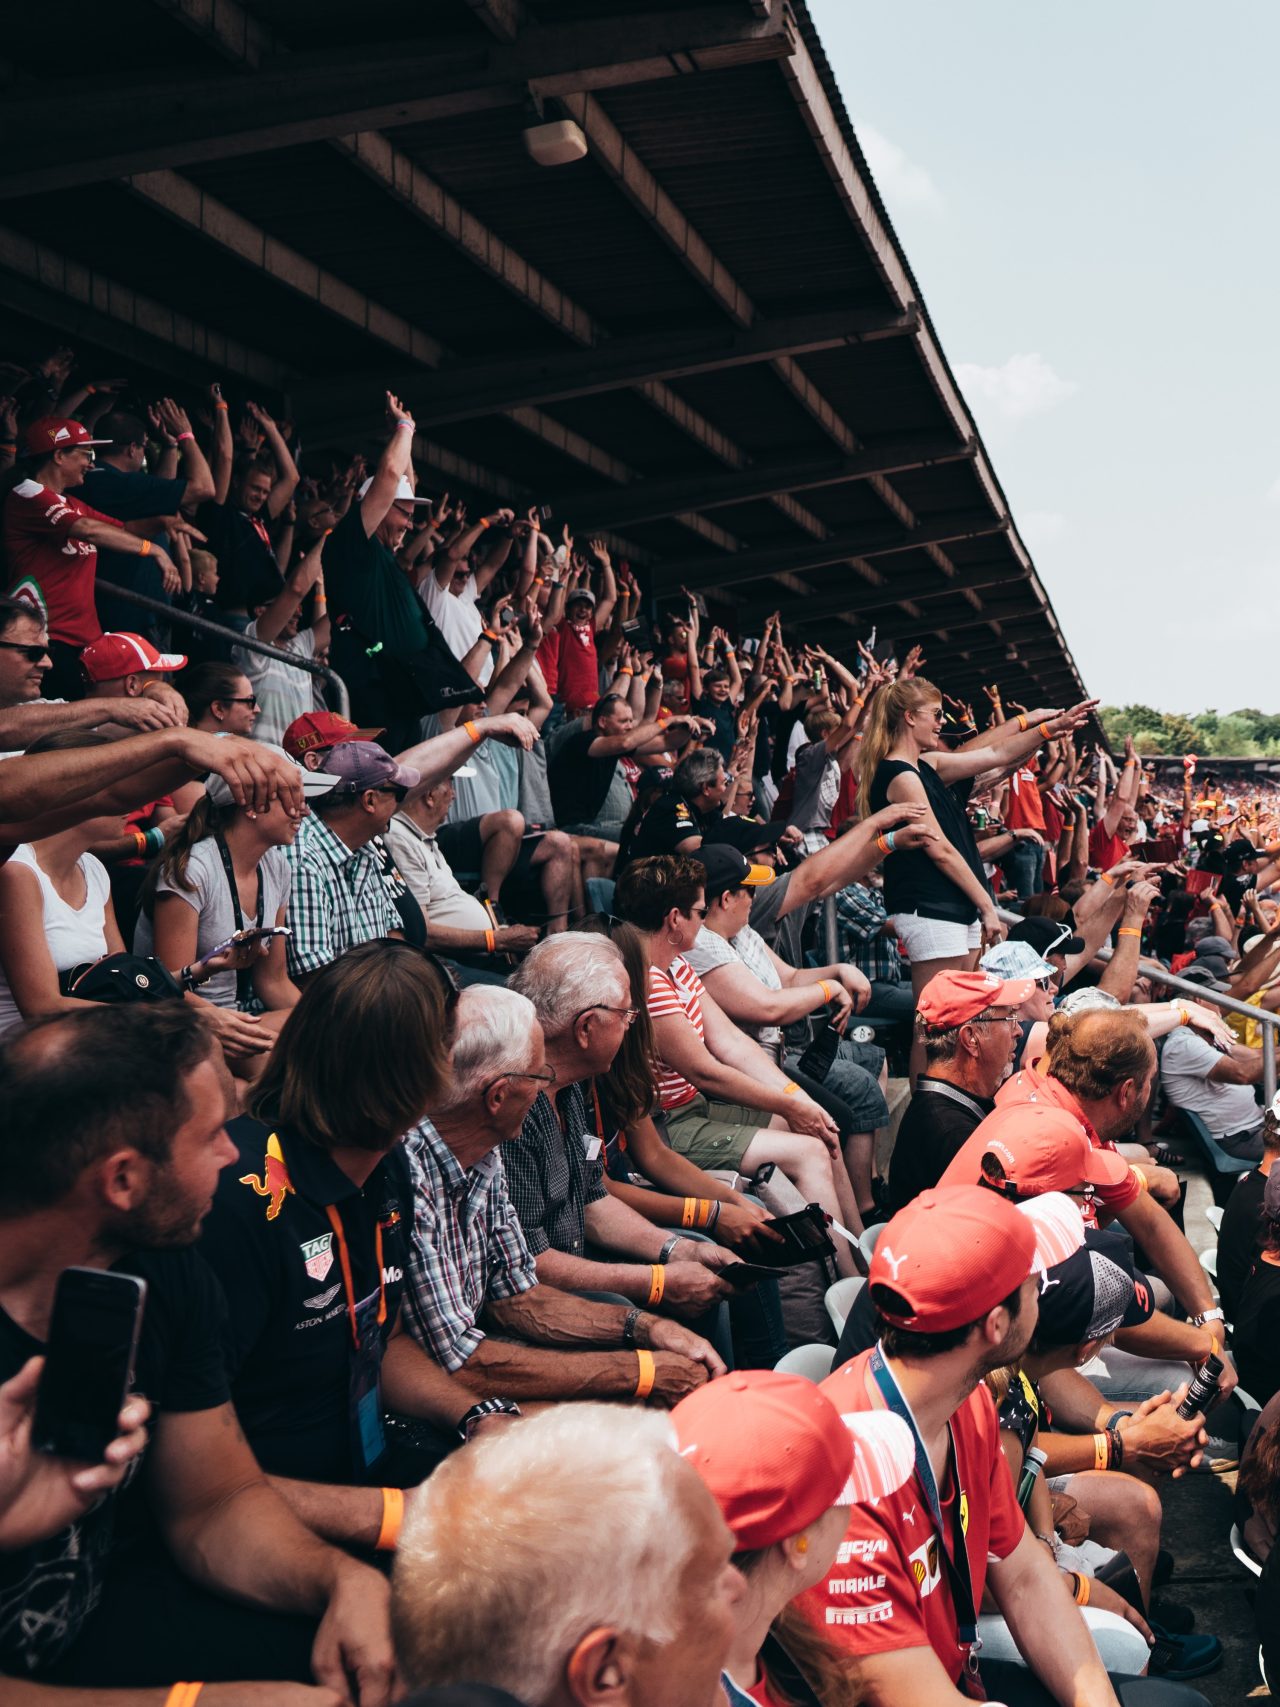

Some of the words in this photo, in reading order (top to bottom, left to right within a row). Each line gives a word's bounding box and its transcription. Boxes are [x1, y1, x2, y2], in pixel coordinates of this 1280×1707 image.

[301, 1236, 329, 1259] TAG
[295, 1317, 323, 1331] ASTON
[829, 1574, 887, 1595] MAHLE
[825, 1600, 894, 1625] PIRELLI
